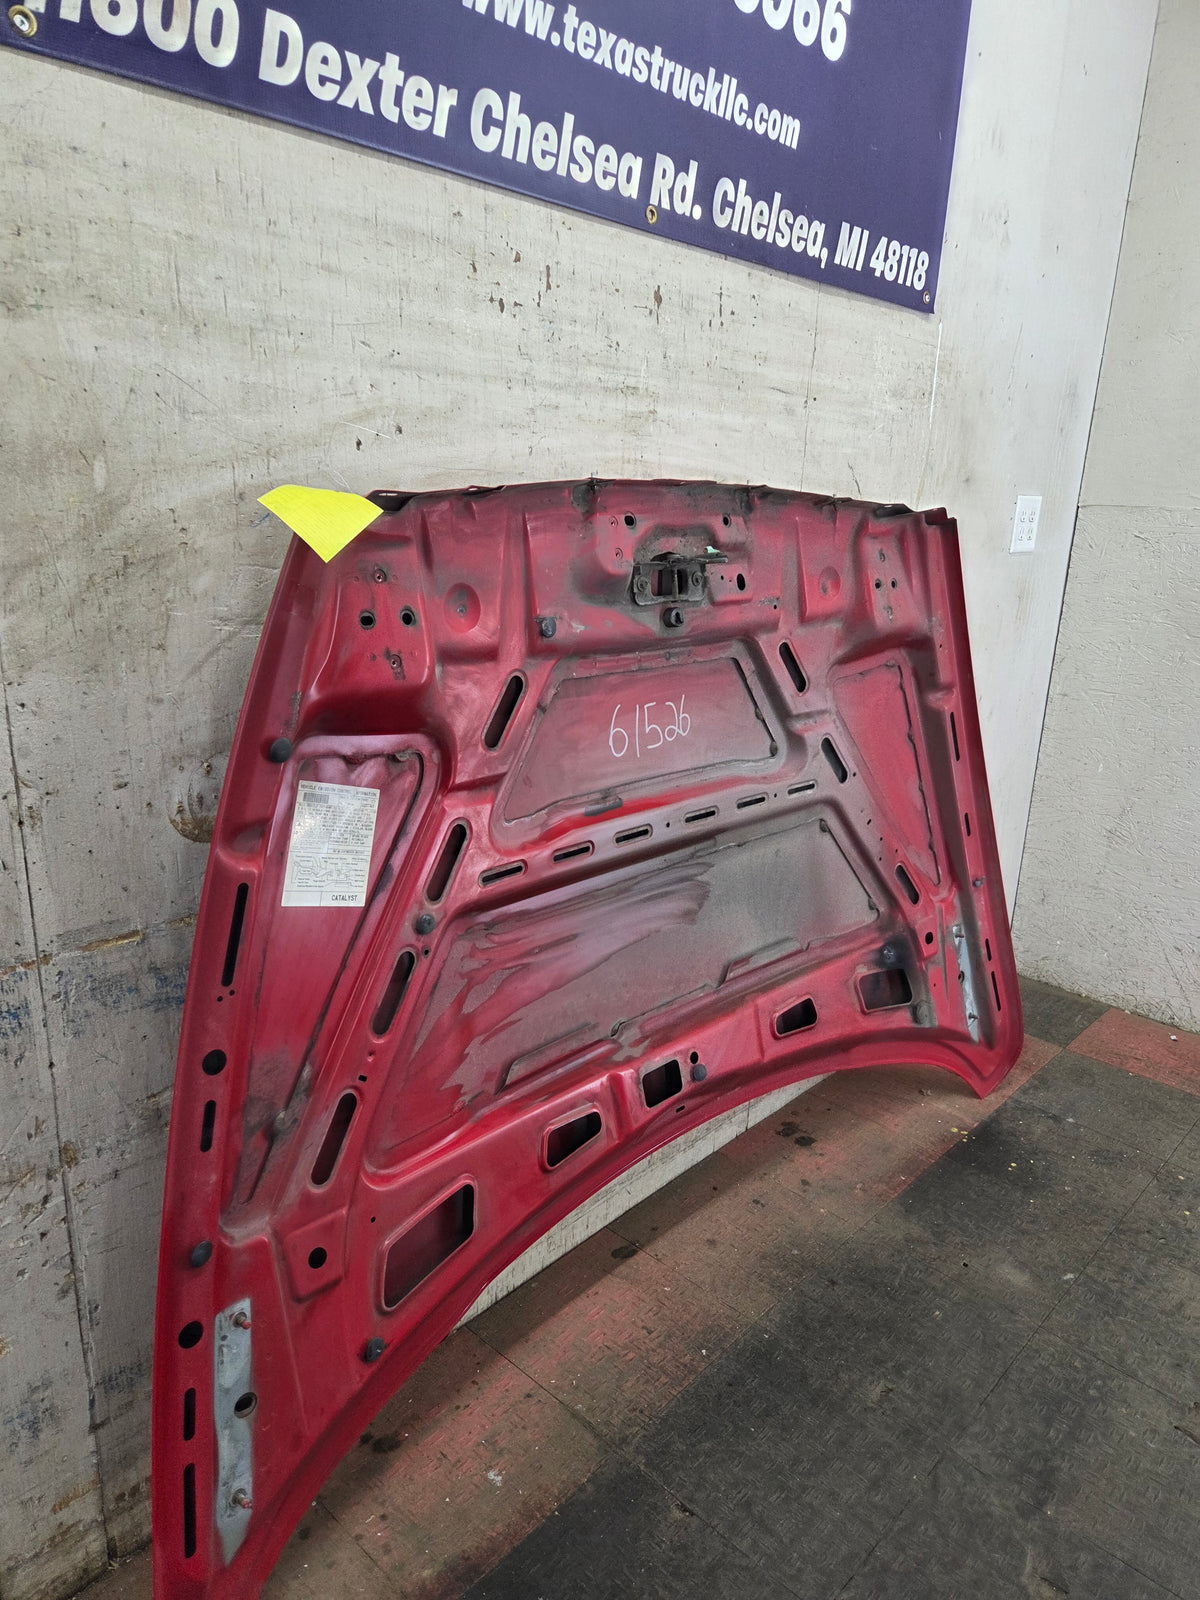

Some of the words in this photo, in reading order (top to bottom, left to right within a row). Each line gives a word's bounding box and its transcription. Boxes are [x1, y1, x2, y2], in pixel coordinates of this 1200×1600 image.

[733, 0, 853, 62] 66
[23, 0, 240, 68] 800
[258, 8, 459, 139] Dexter
[470, 87, 644, 201] Chelsea
[649, 152, 703, 221] Rd.
[712, 176, 829, 269] Chelsea,
[833, 221, 870, 272] MI
[870, 235, 930, 291] 48118
[608, 693, 691, 758] 61526
[331, 894, 358, 902] CATALYST
